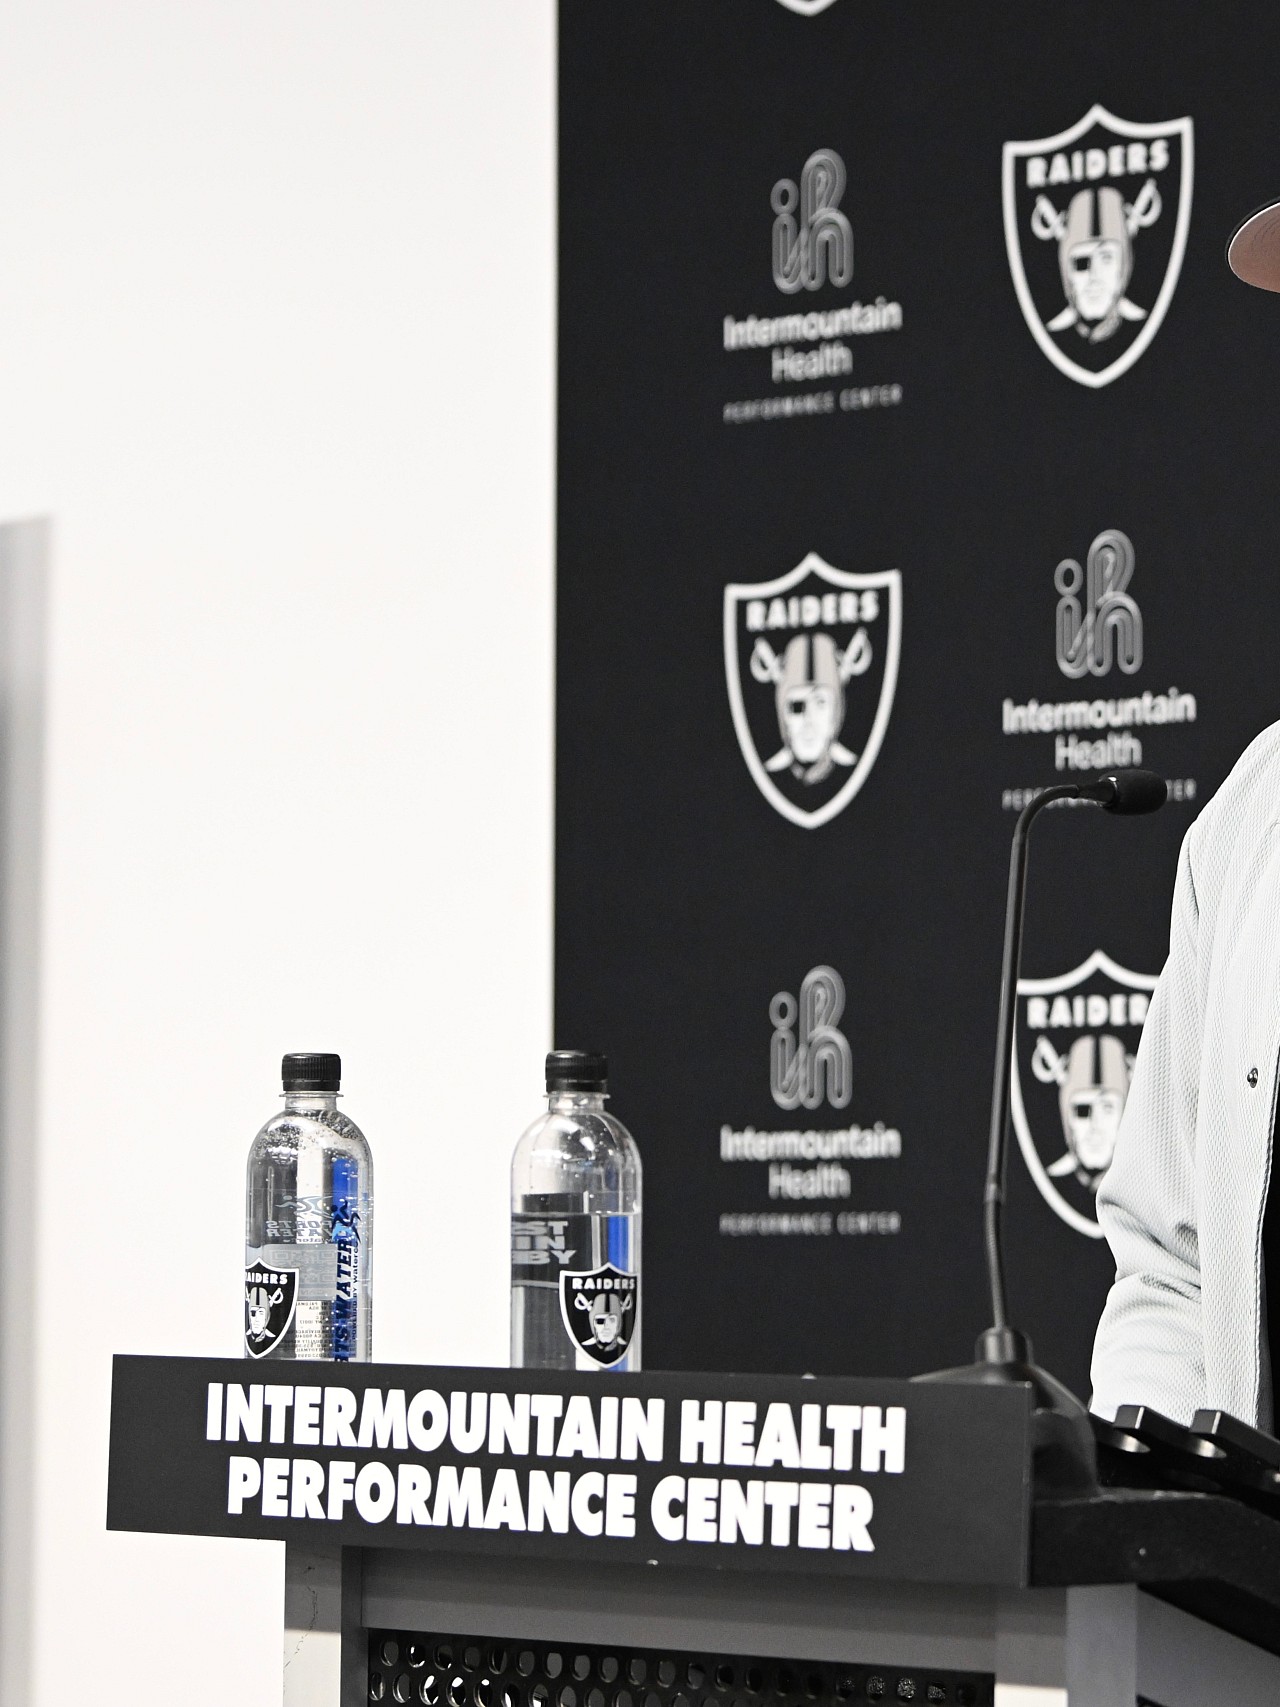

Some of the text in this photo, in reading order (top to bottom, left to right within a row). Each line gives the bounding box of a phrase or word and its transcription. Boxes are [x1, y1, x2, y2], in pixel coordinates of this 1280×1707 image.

[1026, 140, 1168, 188] RAIDERS
[723, 296, 903, 351] Intermountain
[772, 340, 853, 383] Health
[746, 591, 879, 631] RAIDERS
[1002, 686, 1197, 734] Intermountain
[1055, 731, 1142, 770] Health
[1027, 993, 1150, 1029] RAIDER
[720, 1121, 901, 1162] Intermountain
[769, 1162, 851, 1199] Health
[245, 1272, 288, 1285] AIDERS
[572, 1278, 635, 1290] RAIDERS
[206, 1382, 906, 1474] INTERMOUNTAIN HEALTH
[226, 1456, 875, 1552] PERFORMANCE CENTER
